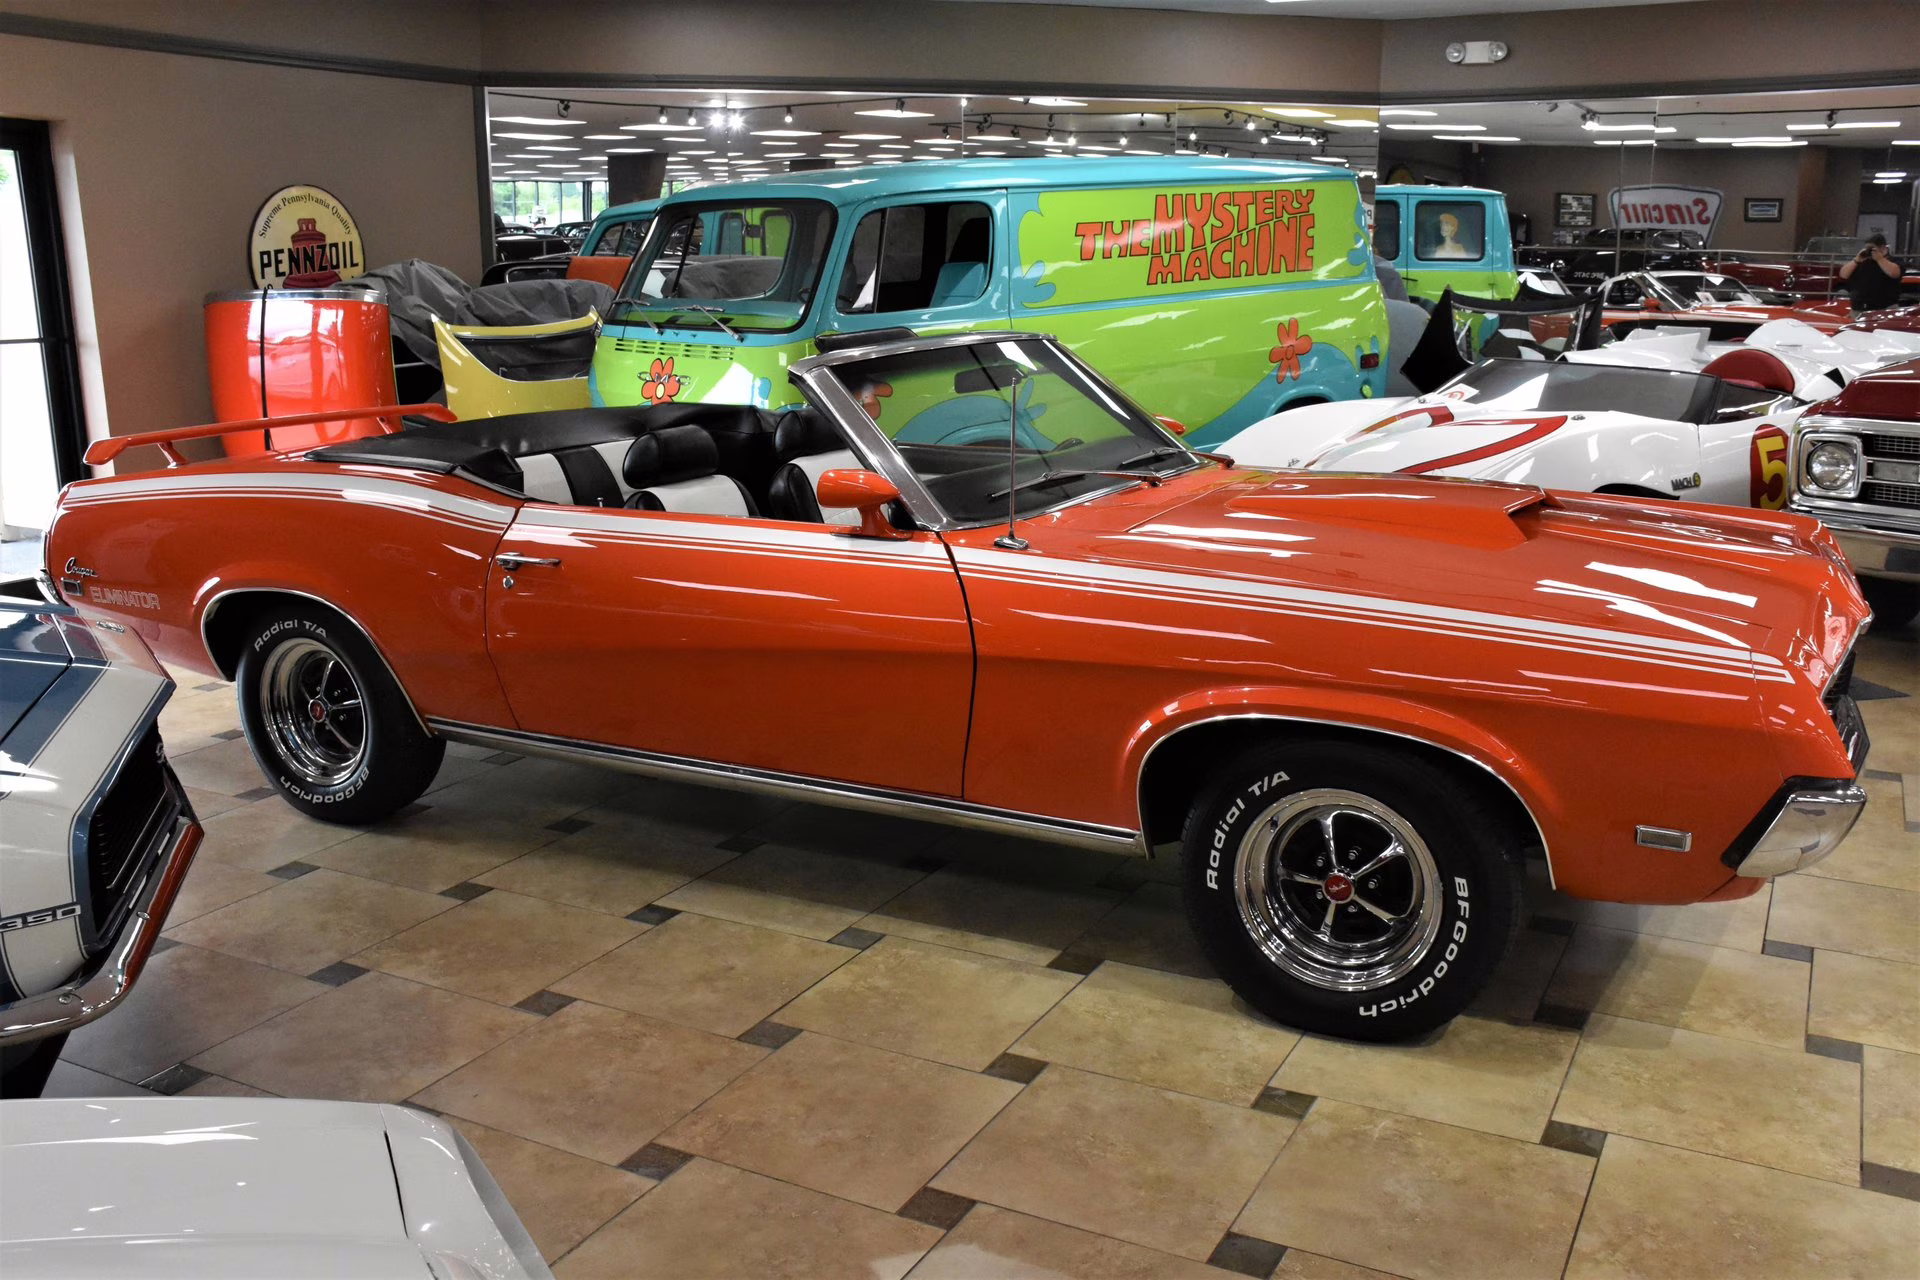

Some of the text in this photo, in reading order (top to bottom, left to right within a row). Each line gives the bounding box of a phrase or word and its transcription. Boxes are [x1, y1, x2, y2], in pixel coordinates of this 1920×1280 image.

[259, 193, 352, 238] Supreme Pennsylvania Quality
[1151, 189, 1315, 256] MYSTERY
[259, 241, 359, 279] PENNZOIL
[1075, 219, 1151, 261] THE
[1147, 213, 1315, 285] MACHINE
[1671, 476, 1694, 491] MACH
[1756, 435, 1788, 510] 5
[65, 557, 98, 578] Cougar
[90, 586, 161, 610] ELIMINATOR
[254, 619, 328, 652] Radial T/A
[280, 766, 369, 804] BFGoodrich
[1206, 770, 1290, 890] Radial T/A
[1358, 876, 1470, 1017] BFGoodrich
